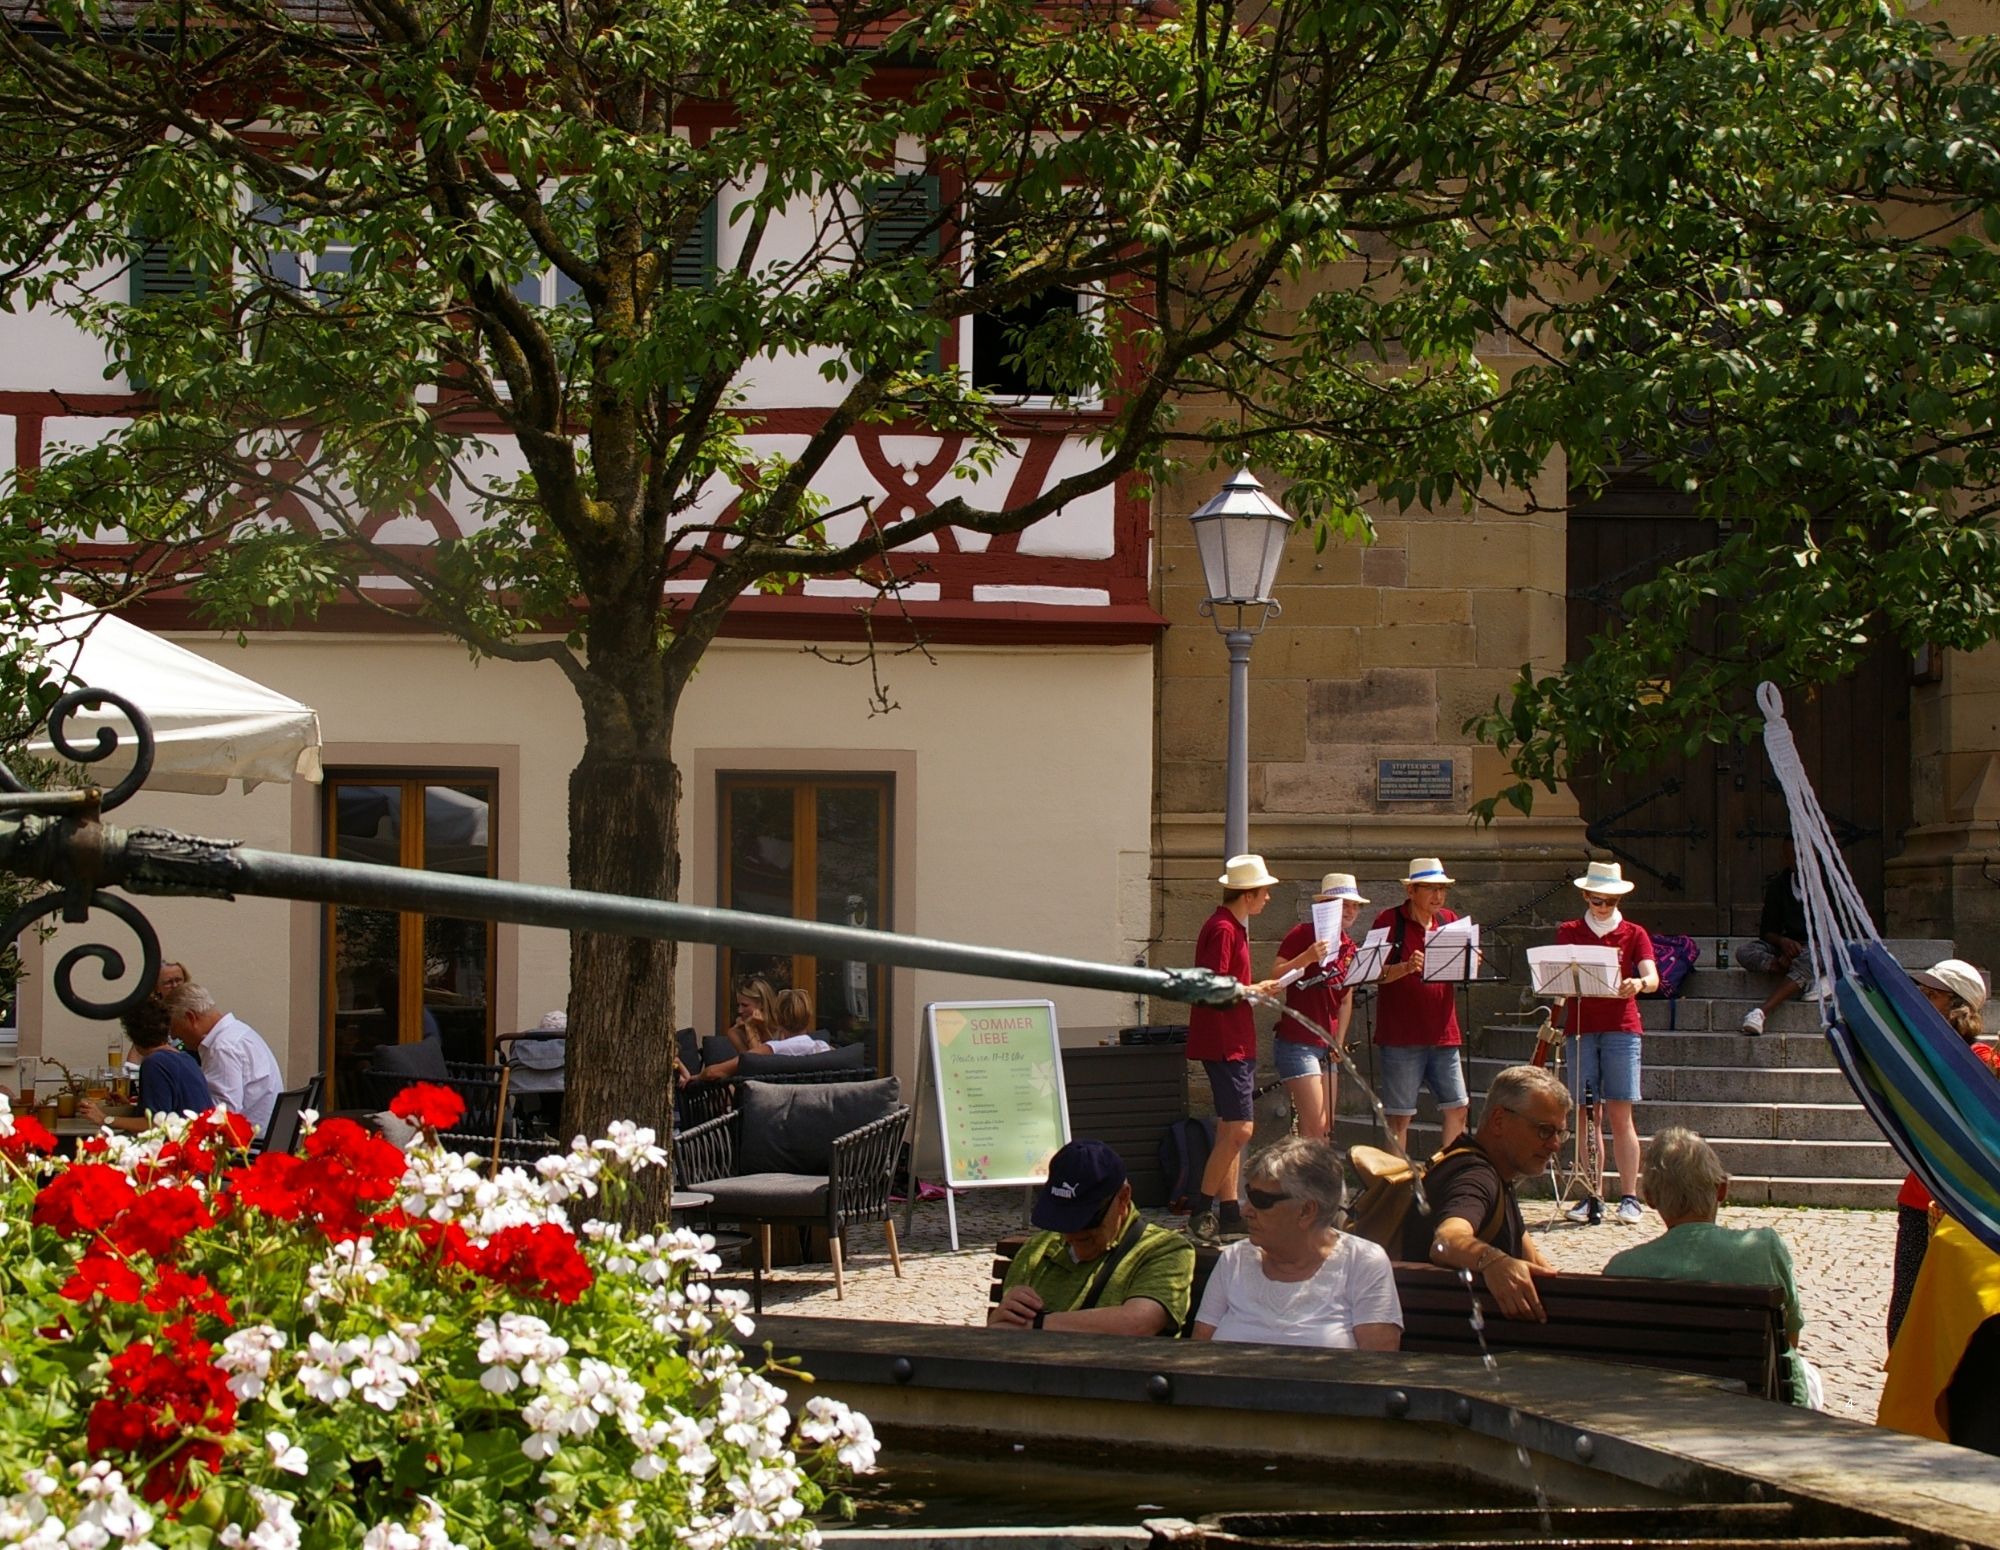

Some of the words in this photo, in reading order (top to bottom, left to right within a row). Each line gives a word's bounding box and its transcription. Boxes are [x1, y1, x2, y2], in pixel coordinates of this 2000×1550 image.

[970, 1017, 1033, 1031] SOMMER
[972, 1032, 1009, 1045] LIEBE
[1051, 1186, 1072, 1199] PUMA
